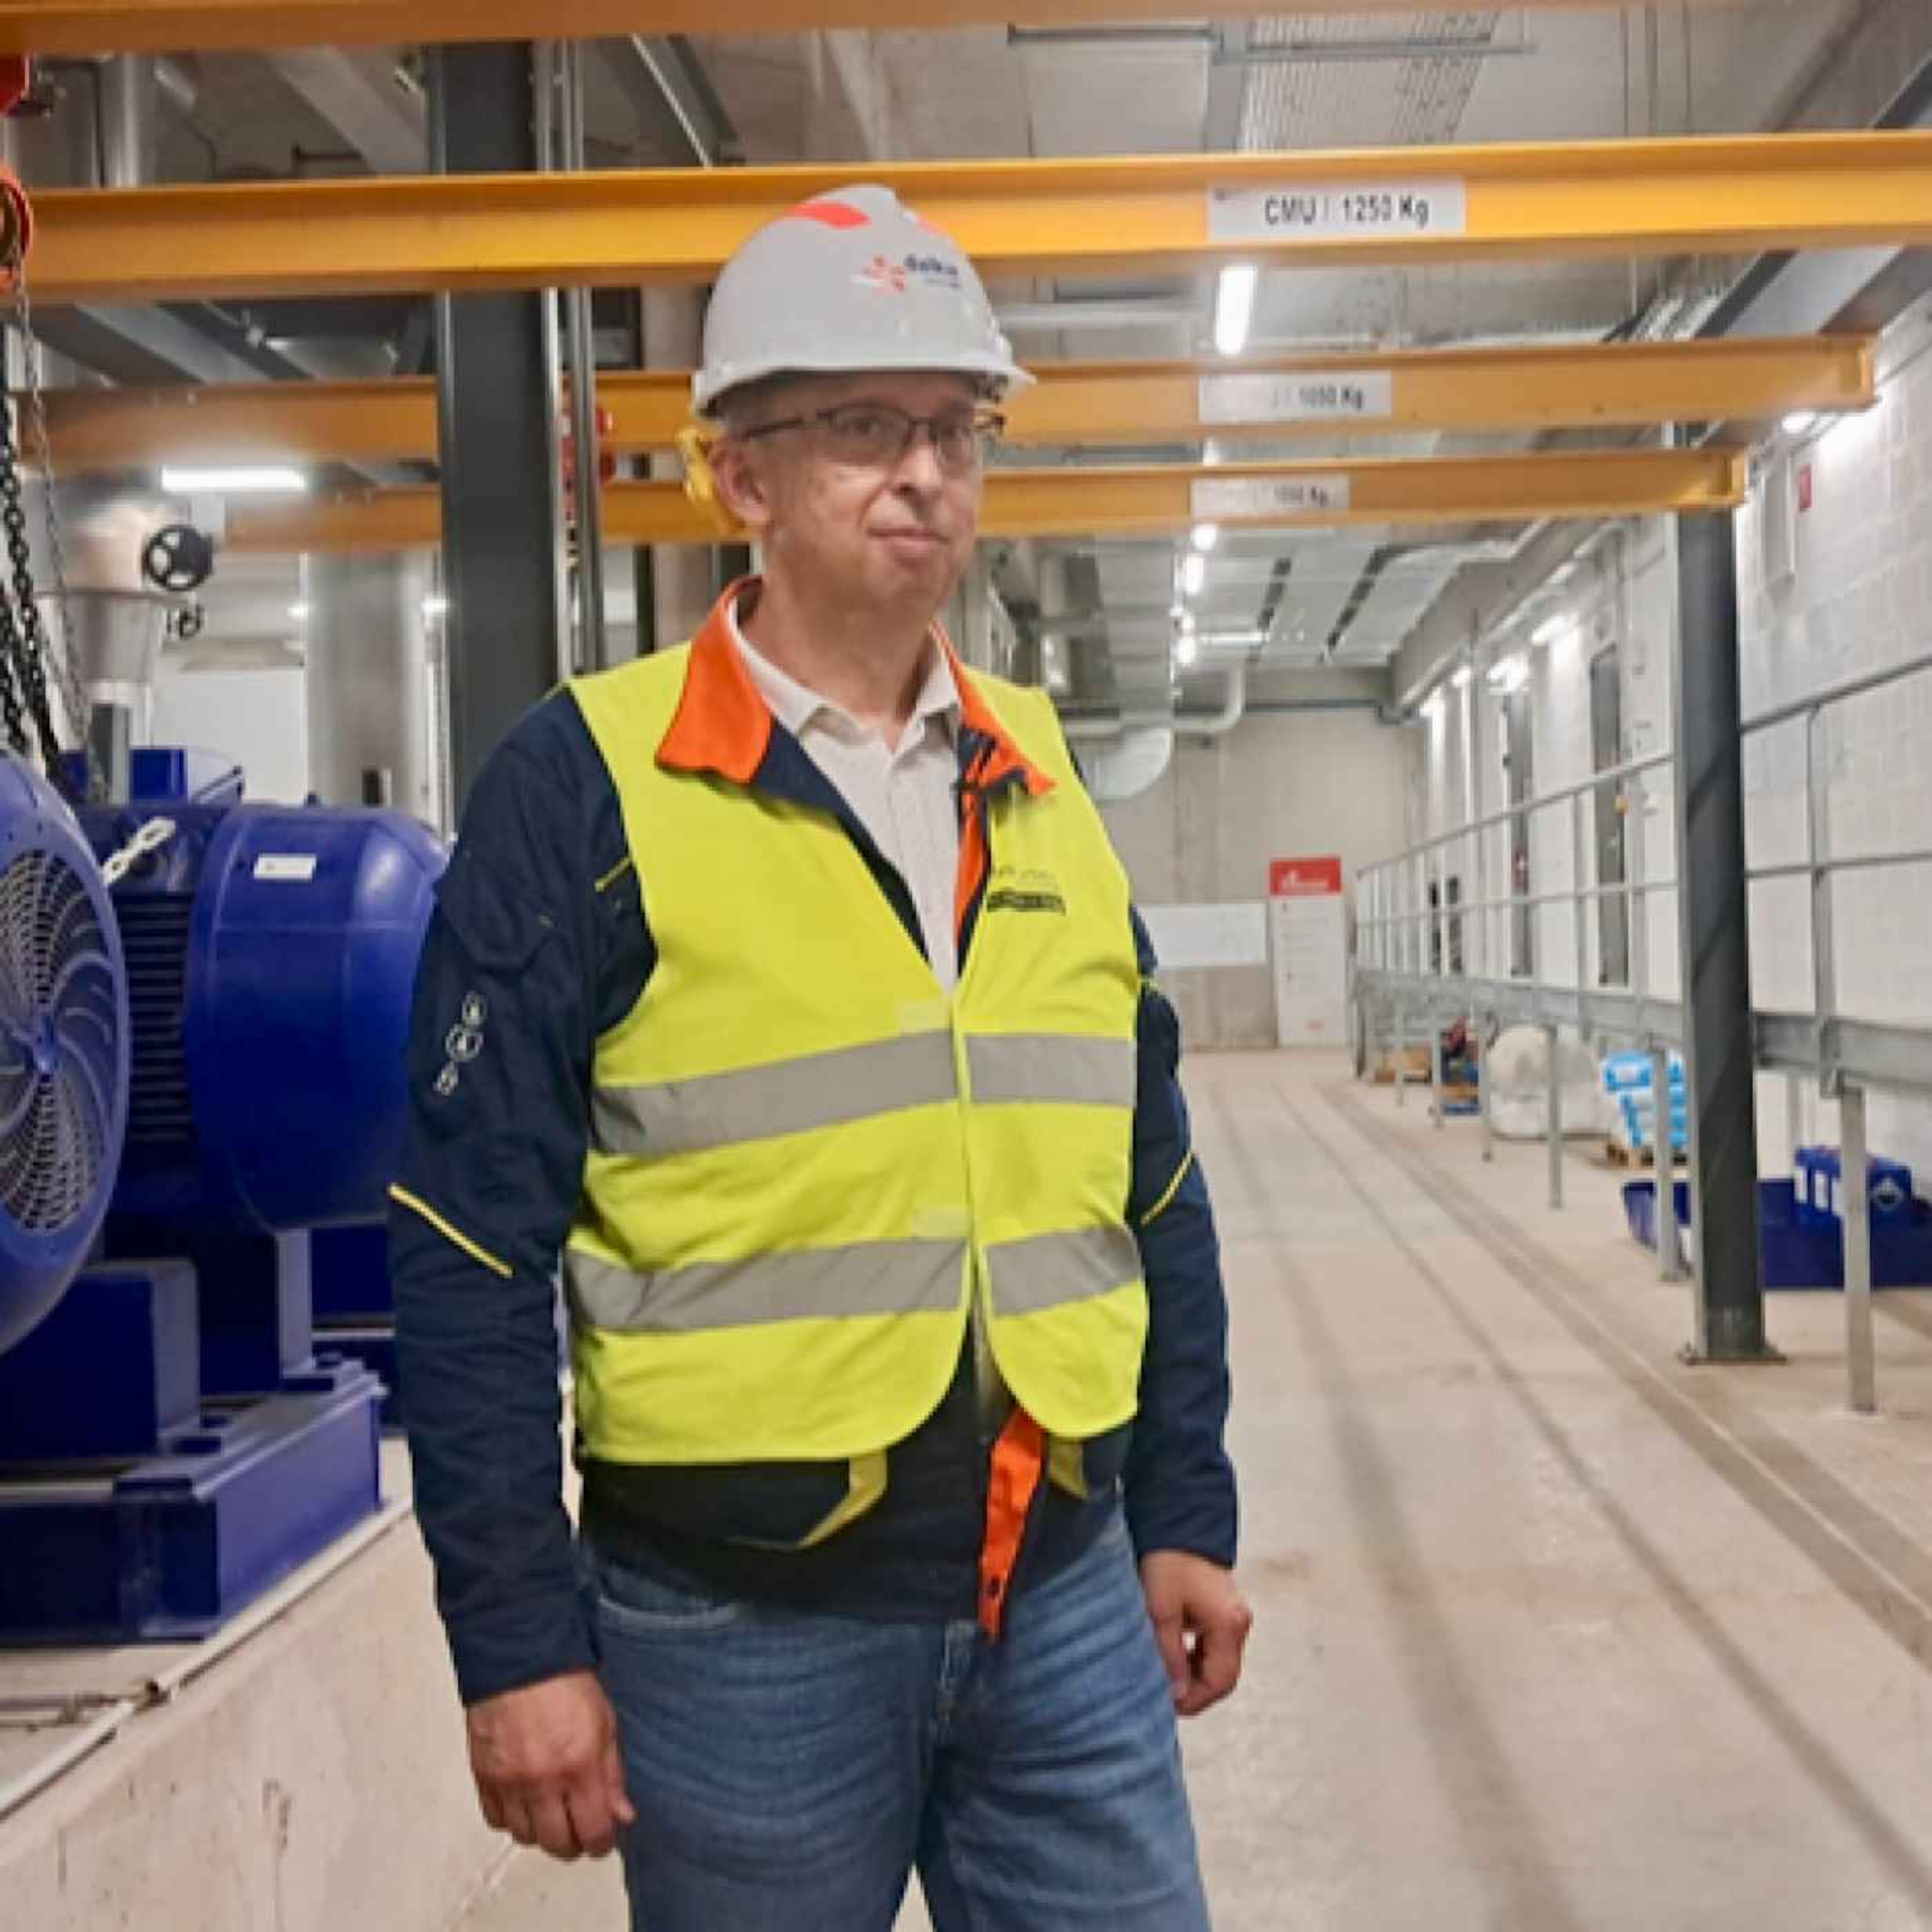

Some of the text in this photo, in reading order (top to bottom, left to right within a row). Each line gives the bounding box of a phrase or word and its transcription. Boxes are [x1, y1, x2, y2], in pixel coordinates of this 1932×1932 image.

[1264, 195, 1317, 225] CMU
[1342, 194, 1392, 222] 1250
[1399, 193, 1430, 229] Kg
